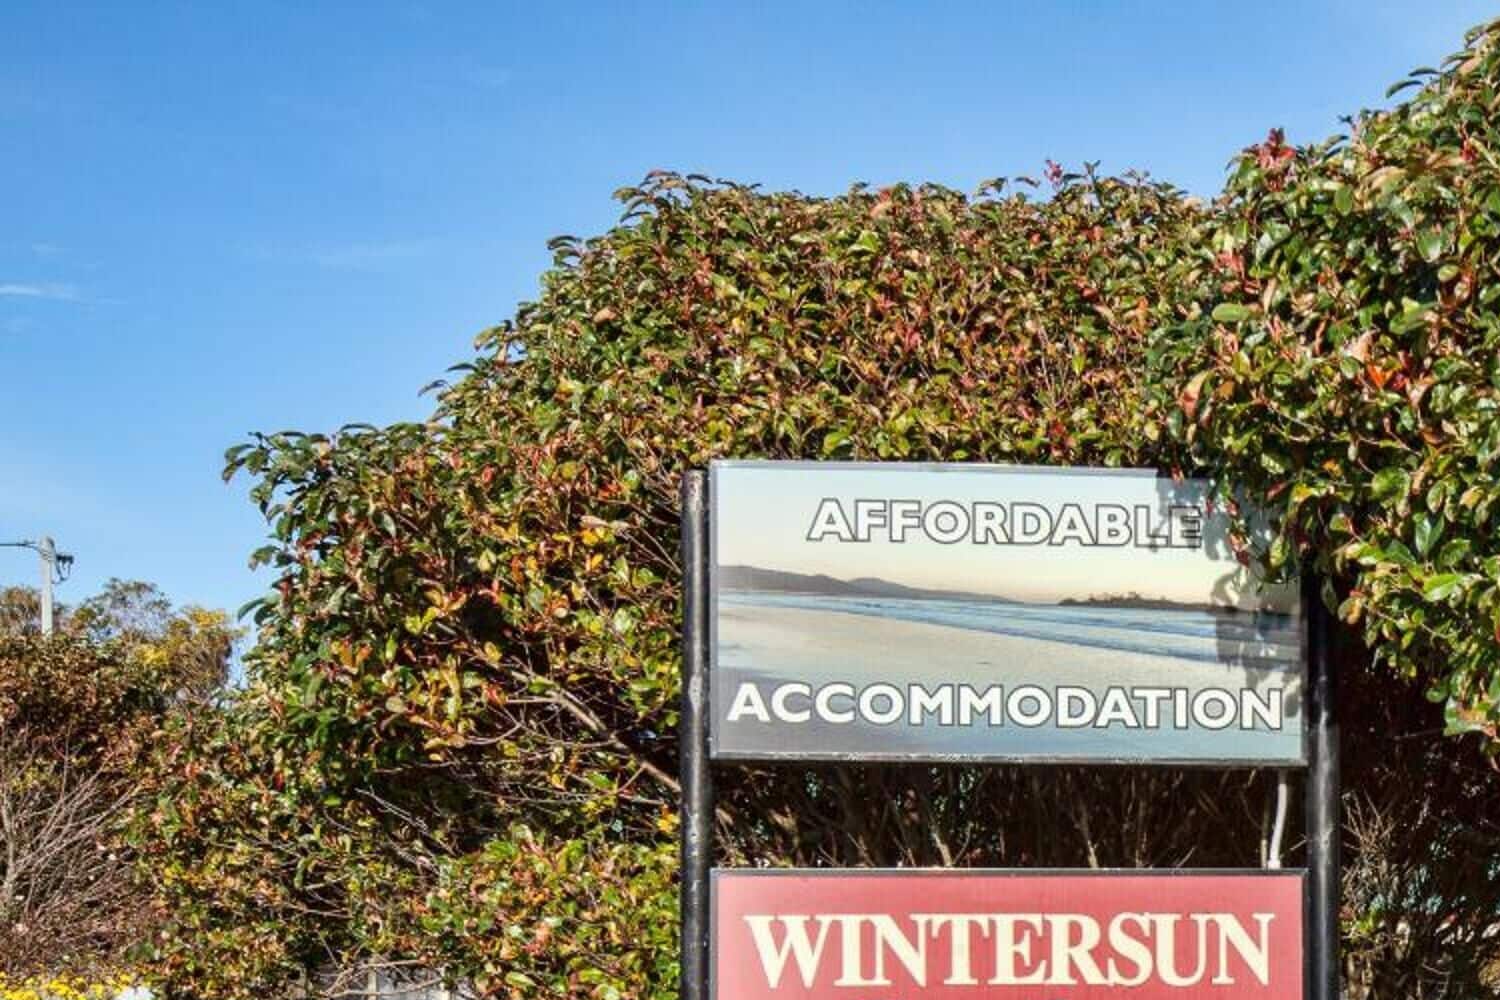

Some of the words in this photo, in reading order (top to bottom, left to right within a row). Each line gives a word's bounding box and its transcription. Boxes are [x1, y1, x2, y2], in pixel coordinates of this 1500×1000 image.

[806, 498, 1201, 548] AFFORDABLE
[726, 681, 1283, 731] ACCOMMODATION
[744, 912, 1275, 988] WINTERSUN
